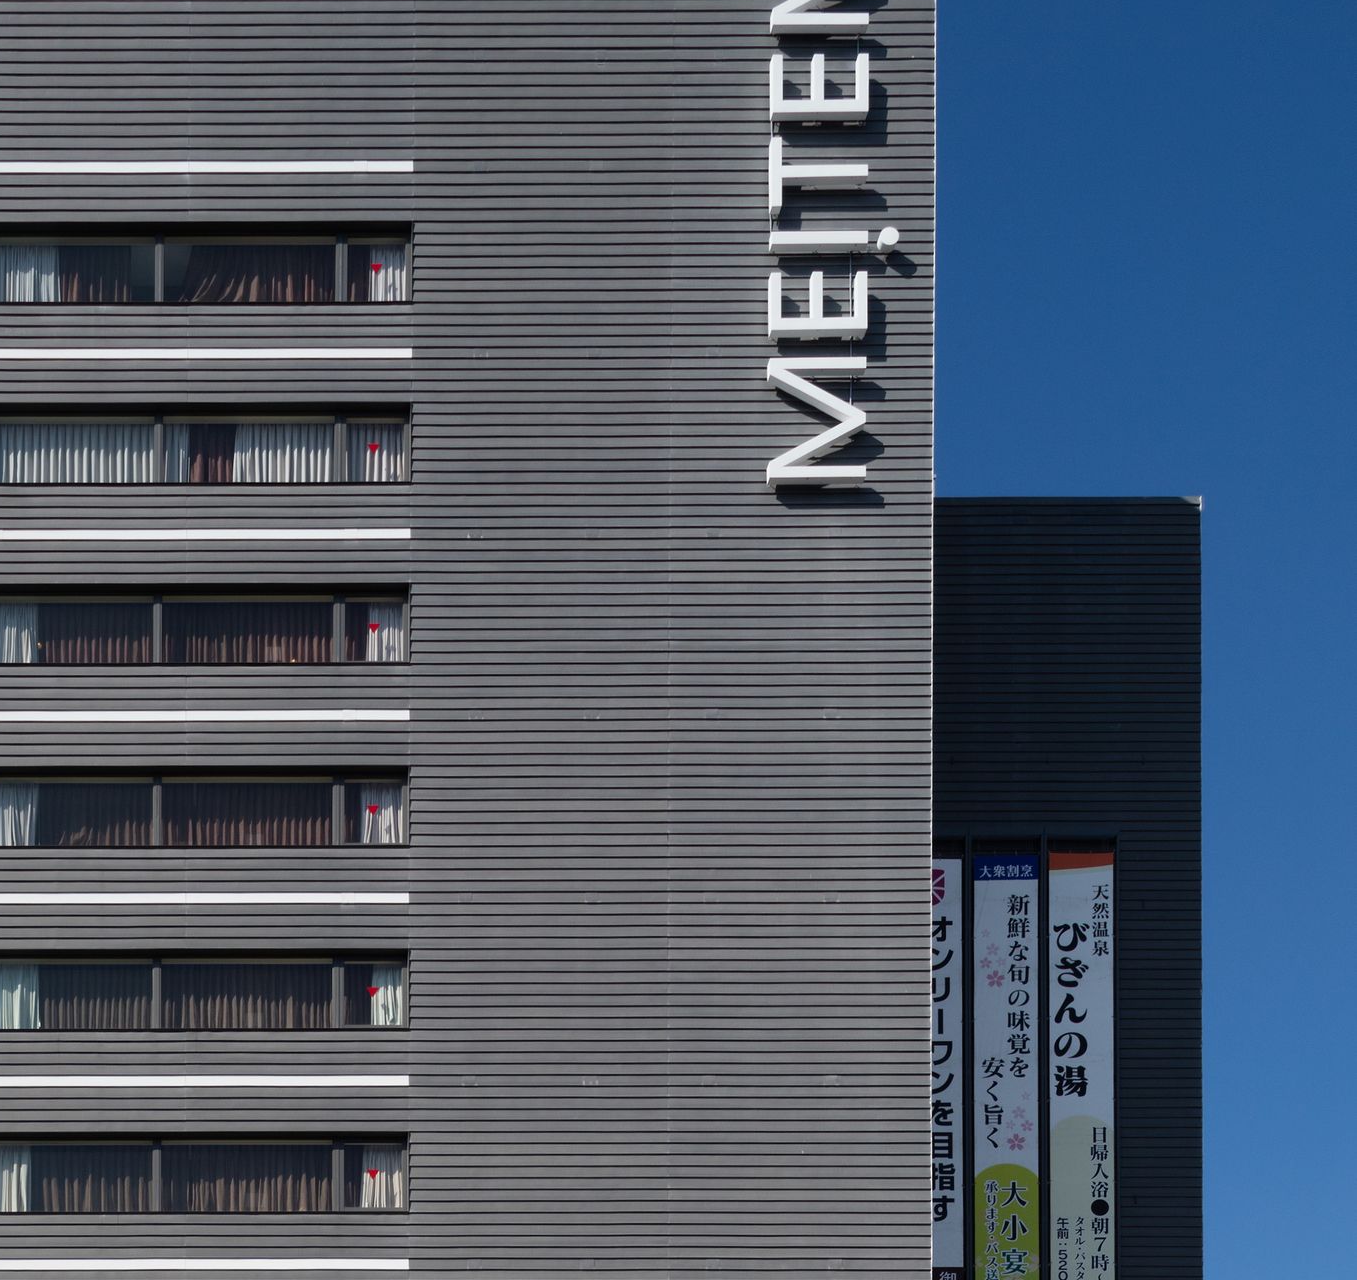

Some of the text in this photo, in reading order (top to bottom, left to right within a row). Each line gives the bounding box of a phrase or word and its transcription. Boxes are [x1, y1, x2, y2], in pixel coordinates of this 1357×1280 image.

[979, 864, 1033, 878] 大衆割烹
[1092, 883, 1110, 957] 天然温泉
[1007, 894, 1031, 1078] 新鮮な旬の味覚を
[1054, 921, 1089, 1097] びざんの湯
[982, 1056, 1005, 1149] 安く旨く
